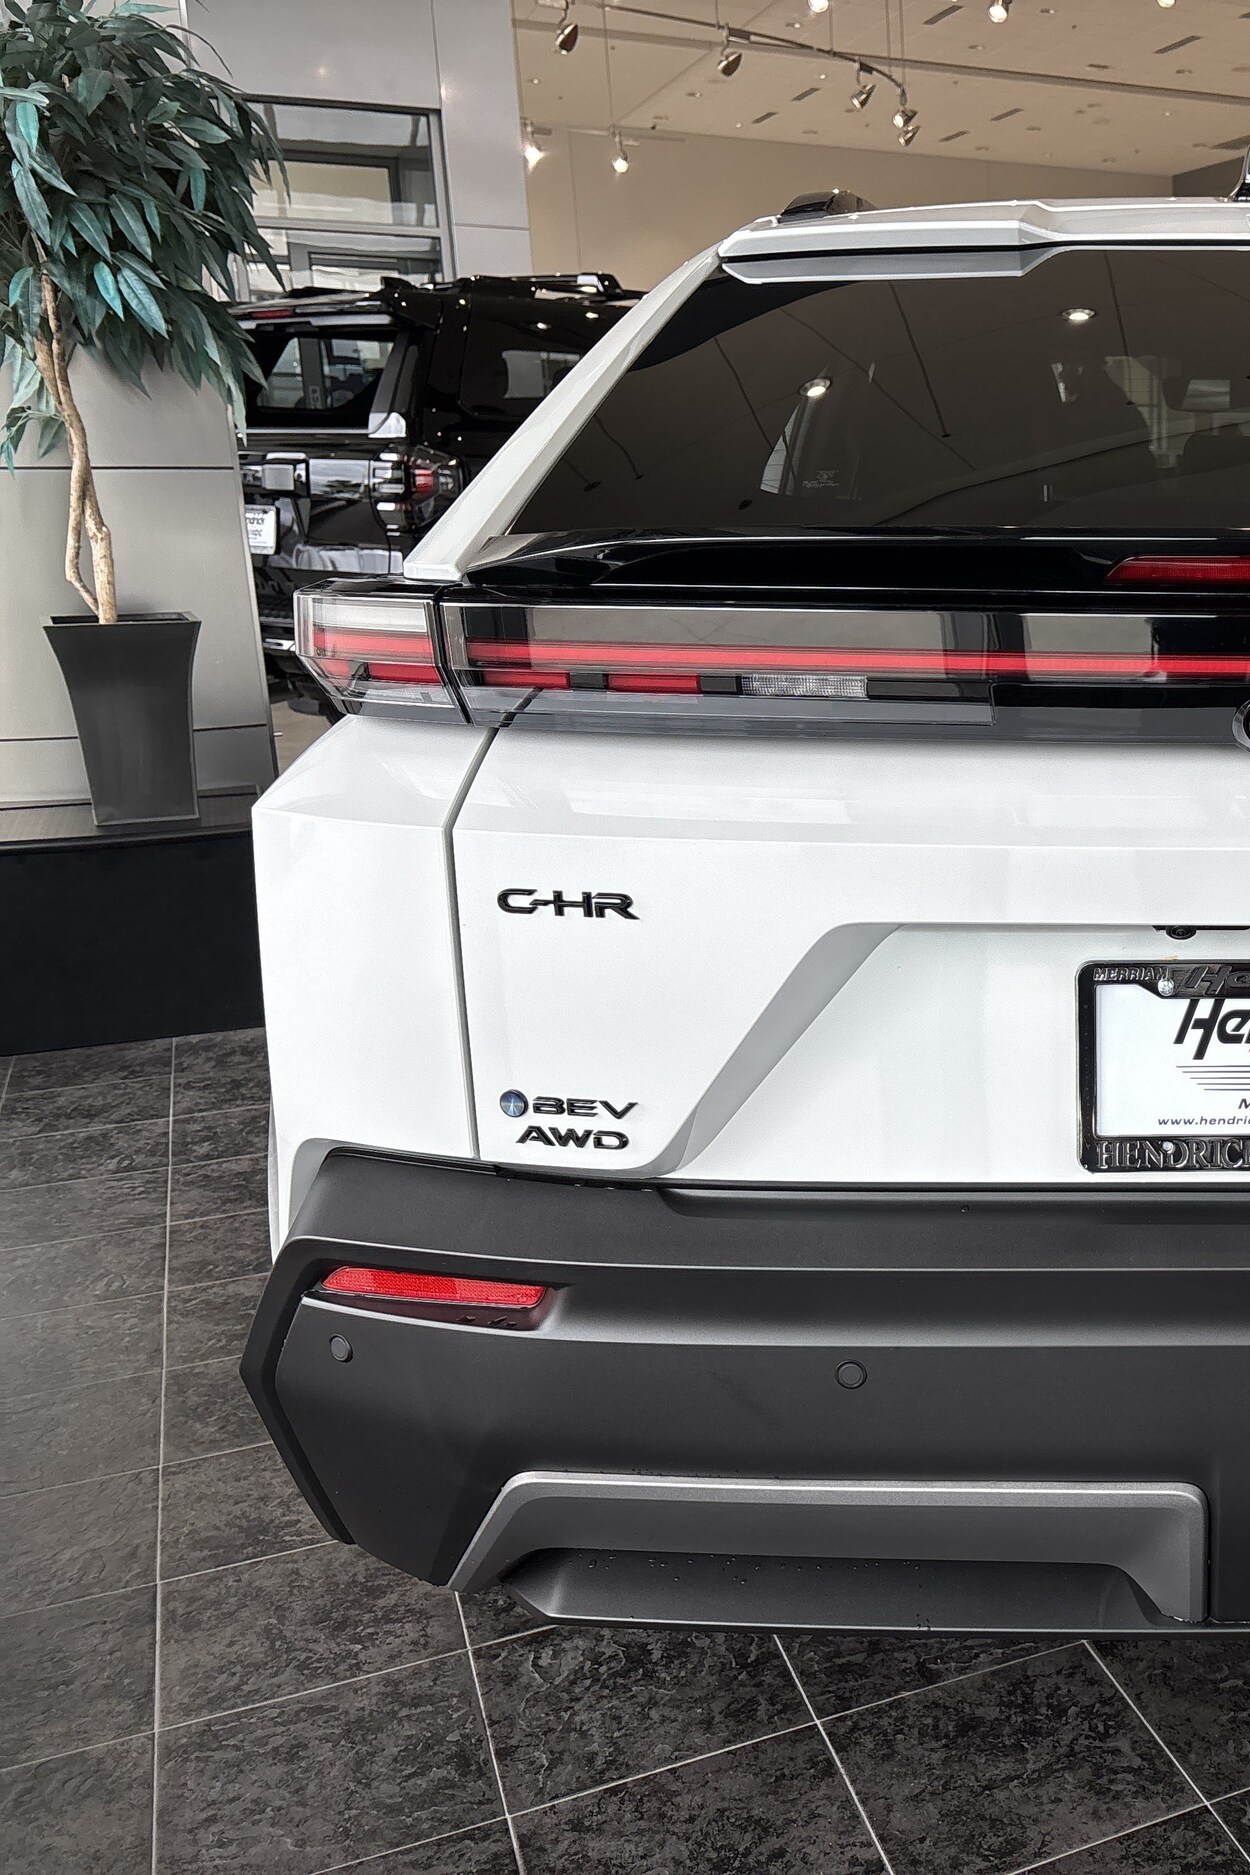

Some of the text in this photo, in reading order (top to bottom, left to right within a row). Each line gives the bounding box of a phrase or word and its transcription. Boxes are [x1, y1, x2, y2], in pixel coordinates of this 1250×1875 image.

[497, 888, 640, 920] C-HR
[1093, 966, 1169, 981] MERRIAM
[532, 1096, 639, 1120] BEV
[515, 1125, 629, 1150] AWD
